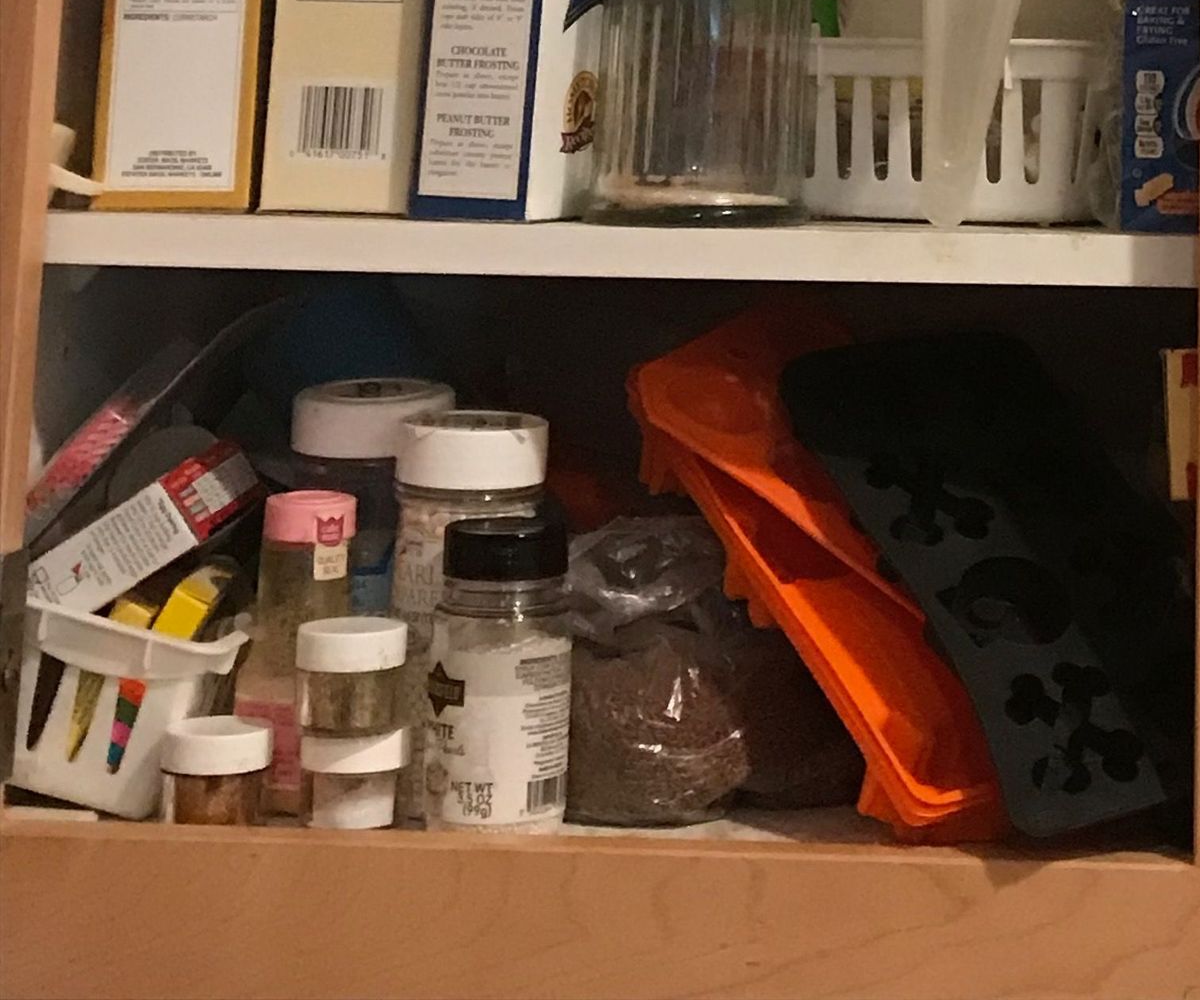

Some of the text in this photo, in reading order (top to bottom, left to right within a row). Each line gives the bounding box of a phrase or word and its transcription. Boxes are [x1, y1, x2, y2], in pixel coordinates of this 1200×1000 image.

[450, 45, 508, 57] CHOCOLATE
[436, 58, 520, 71] BUTTER FROSTING
[436, 113, 511, 126] PEANUT BUTTER
[448, 127, 496, 138] FROSTING
